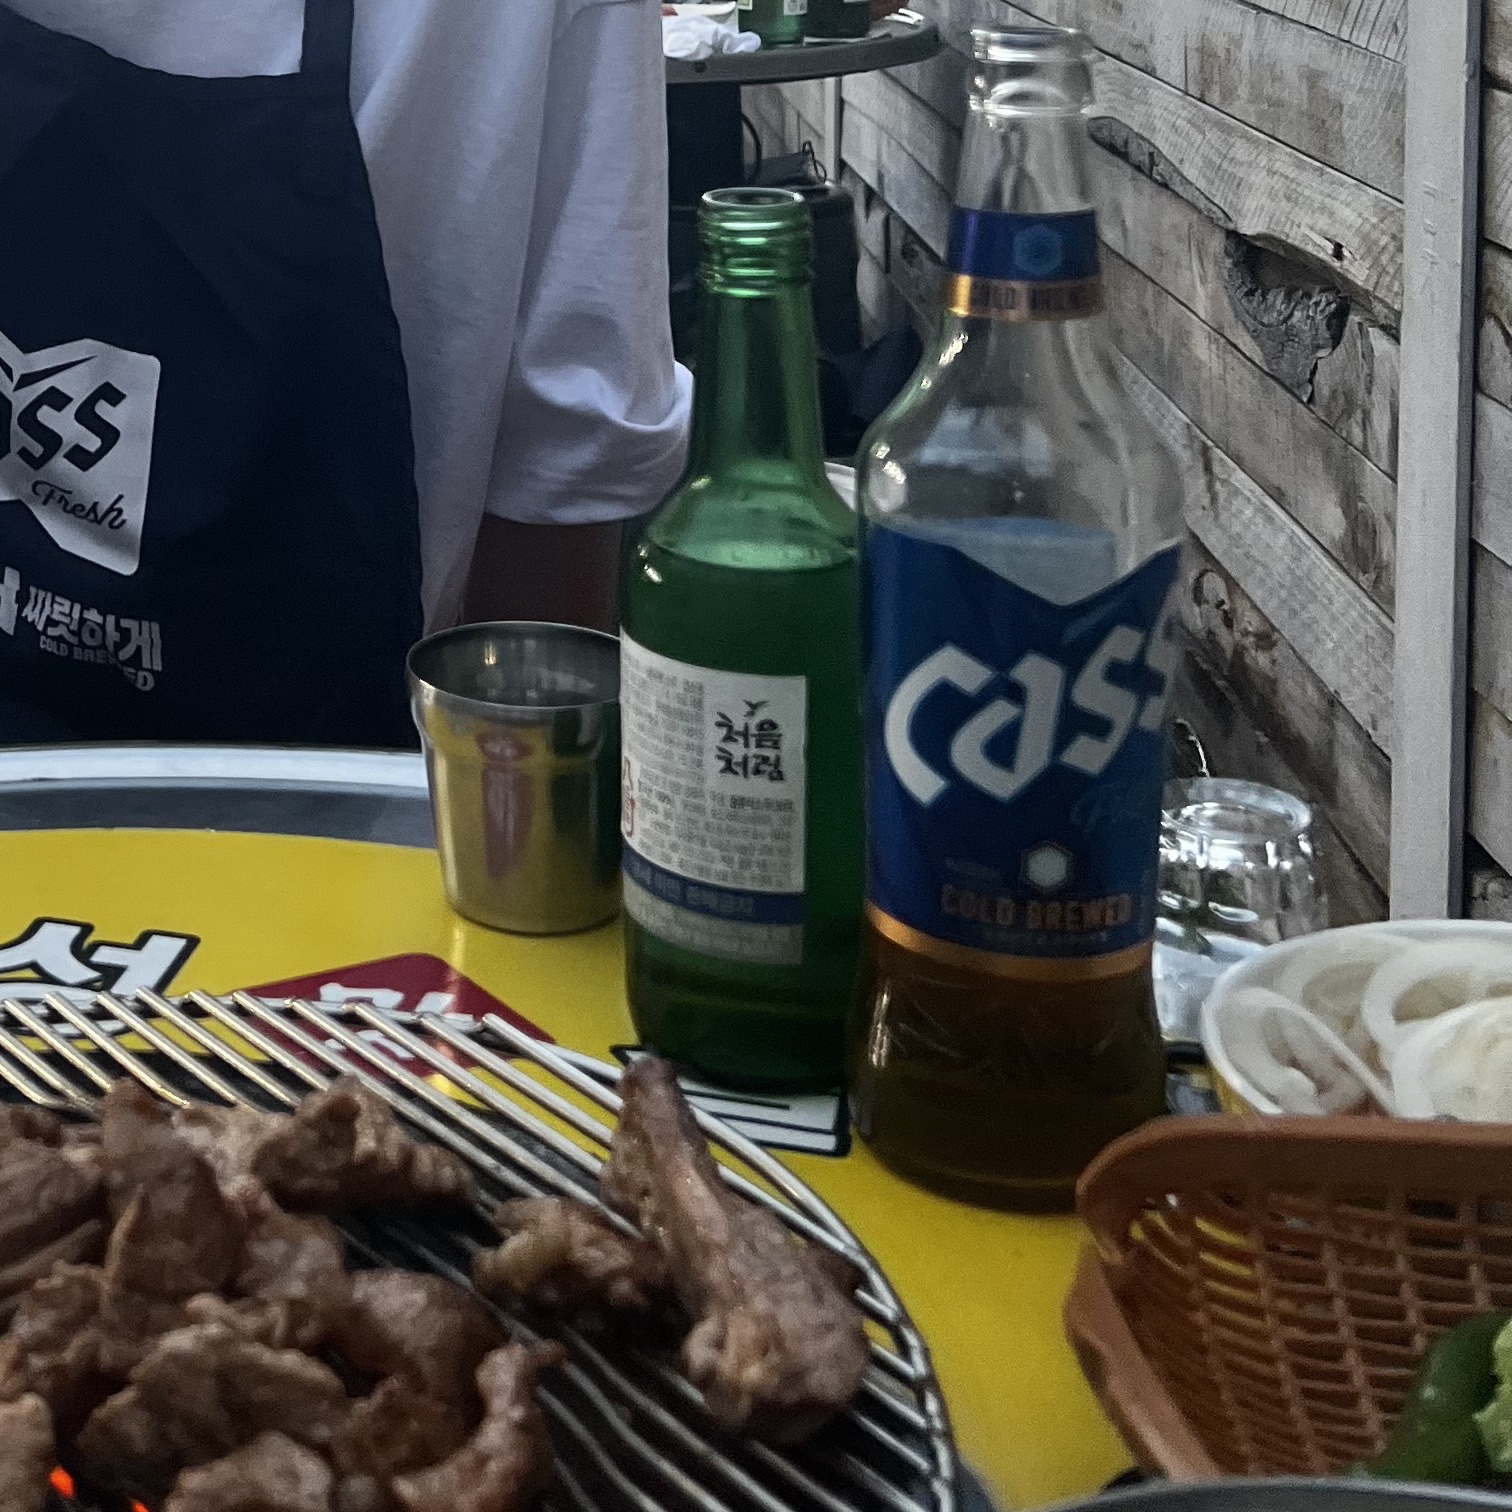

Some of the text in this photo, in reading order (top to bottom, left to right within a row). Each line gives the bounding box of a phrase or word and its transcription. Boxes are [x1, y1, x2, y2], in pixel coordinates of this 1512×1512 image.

[32, 480, 127, 530] Fresh
[22, 585, 163, 672] 짜릿하게
[39, 635, 69, 657] COLD
[714, 711, 785, 750] 처음
[714, 746, 786, 782] 처럼
[942, 883, 1014, 927] COLD
